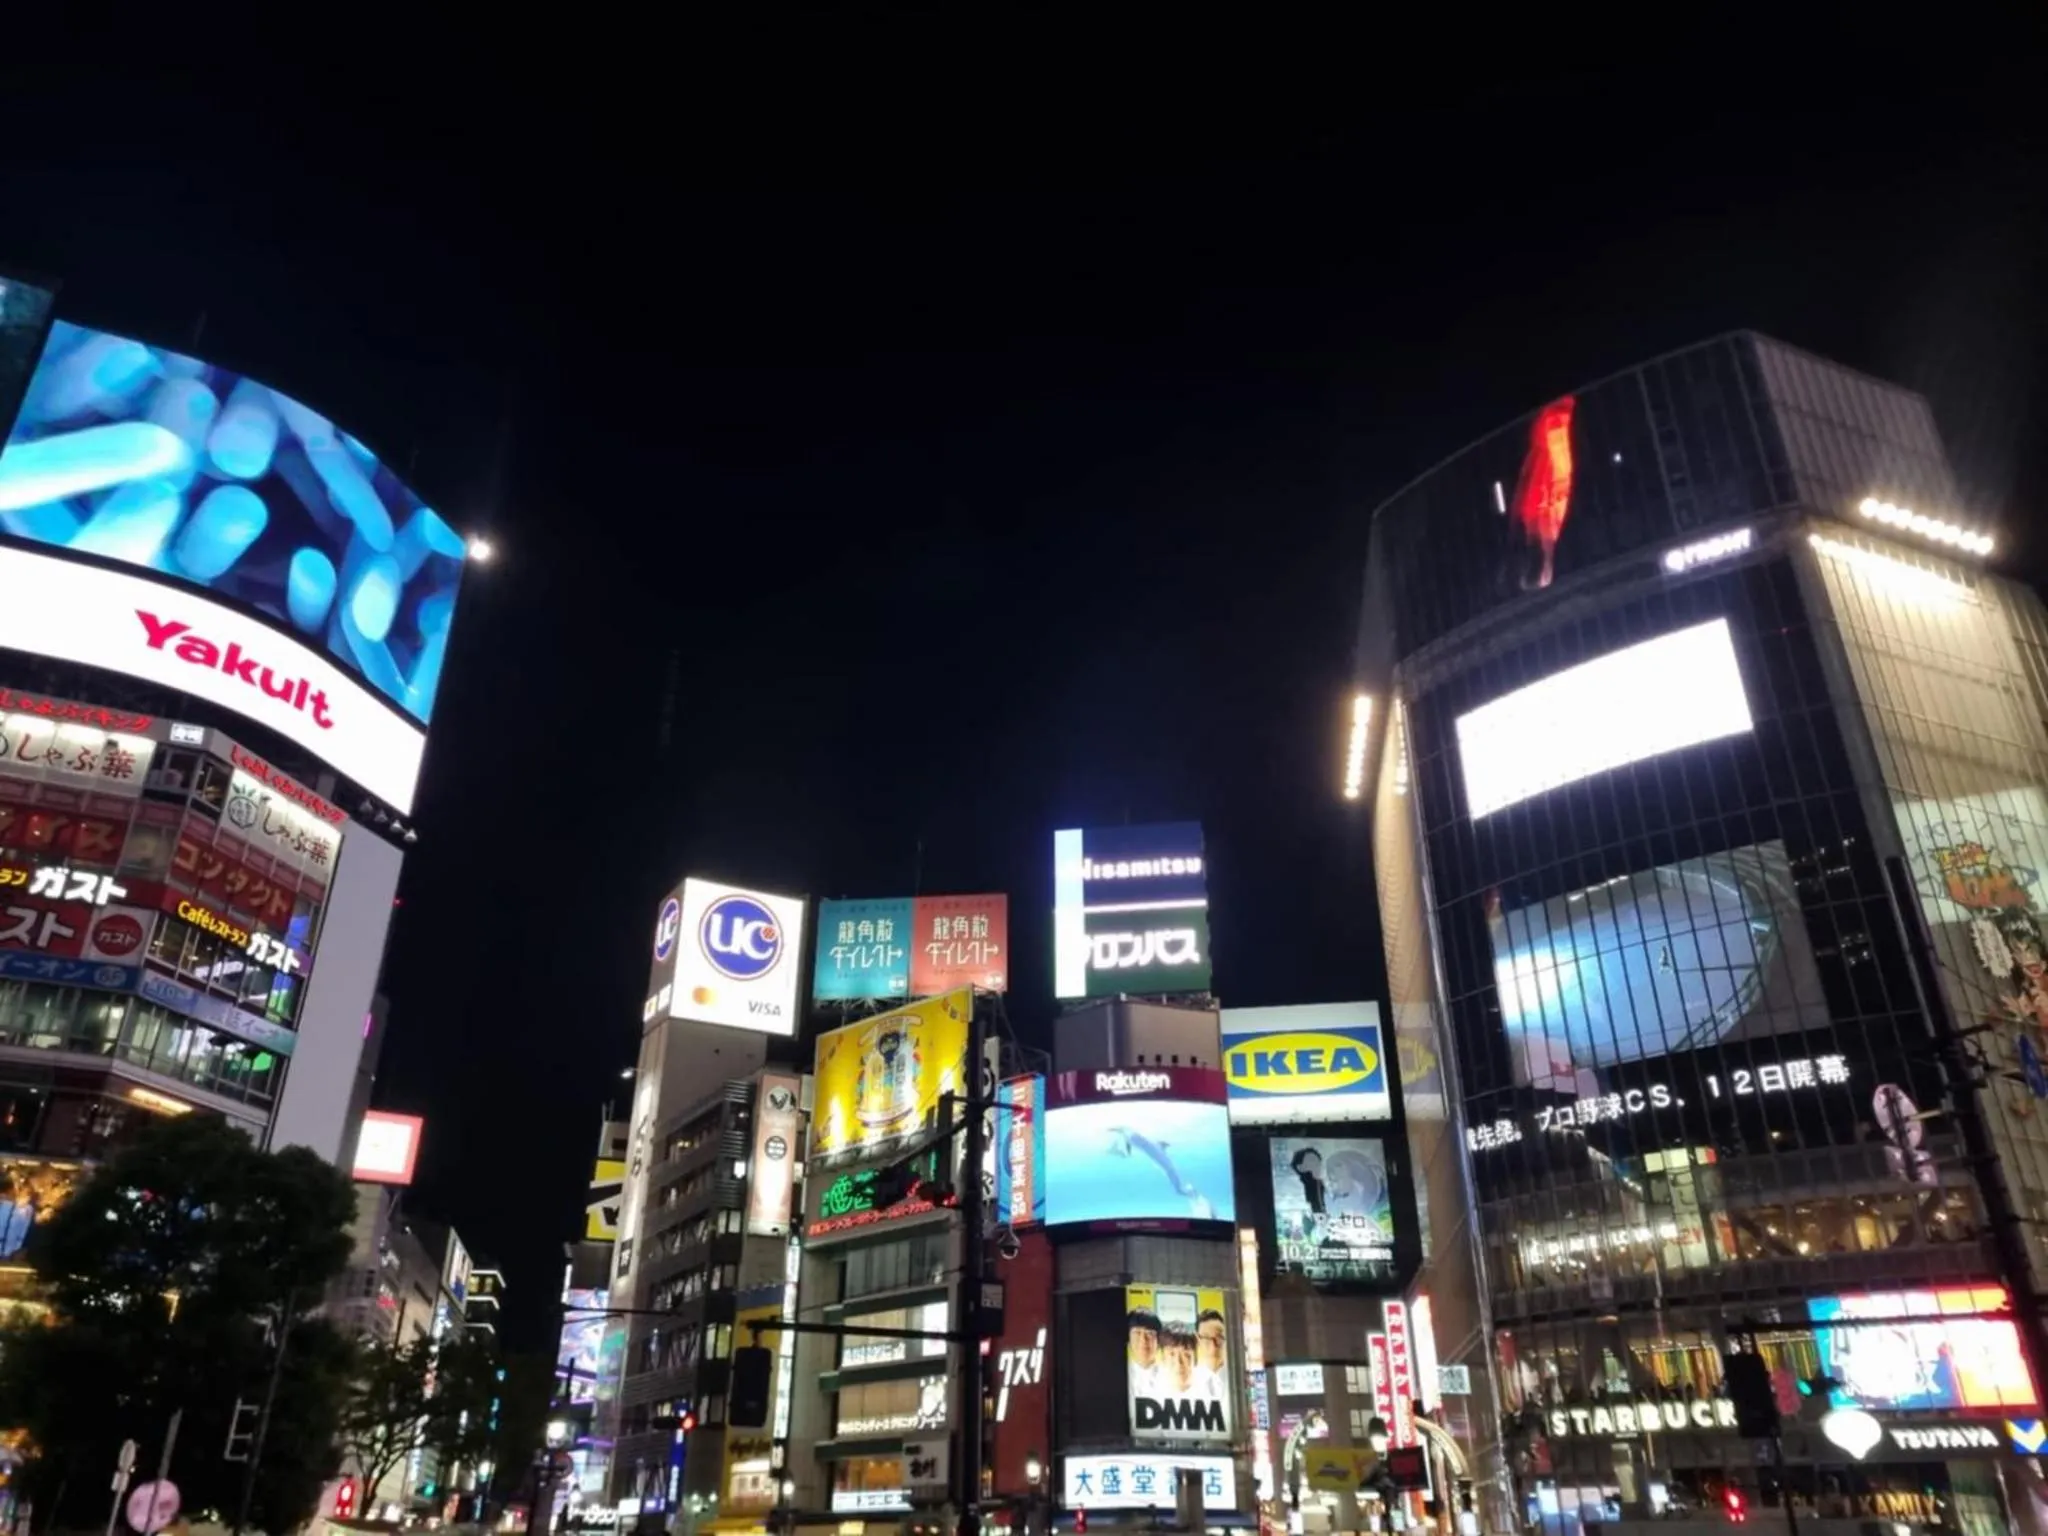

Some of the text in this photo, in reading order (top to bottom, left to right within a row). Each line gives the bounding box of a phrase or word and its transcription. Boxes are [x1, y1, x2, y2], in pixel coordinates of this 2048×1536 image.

[135, 609, 334, 730] Yakult
[17, 733, 137, 779] しゃぶ葉
[262, 808, 330, 866] しゃぶ葉
[28, 866, 128, 905] ガスト
[0, 906, 75, 948] スト
[100, 931, 137, 947] ガスト
[709, 912, 778, 961] UC
[838, 917, 894, 944] 龍角散
[933, 914, 989, 941] 龍角散
[246, 932, 300, 973] ガスト
[829, 944, 904, 969] ダイレクト
[925, 940, 1000, 967] ダイレクト
[747, 1000, 782, 1017] VISA
[1230, 1046, 1369, 1079] IKEA
[1096, 1070, 1170, 1092] Rakuten
[996, 1327, 1047, 1422] クスリ
[1134, 1398, 1226, 1432] DMM
[1551, 1400, 1739, 1437] STARBUCK
[1889, 1427, 2000, 1450] TSUTAYA
